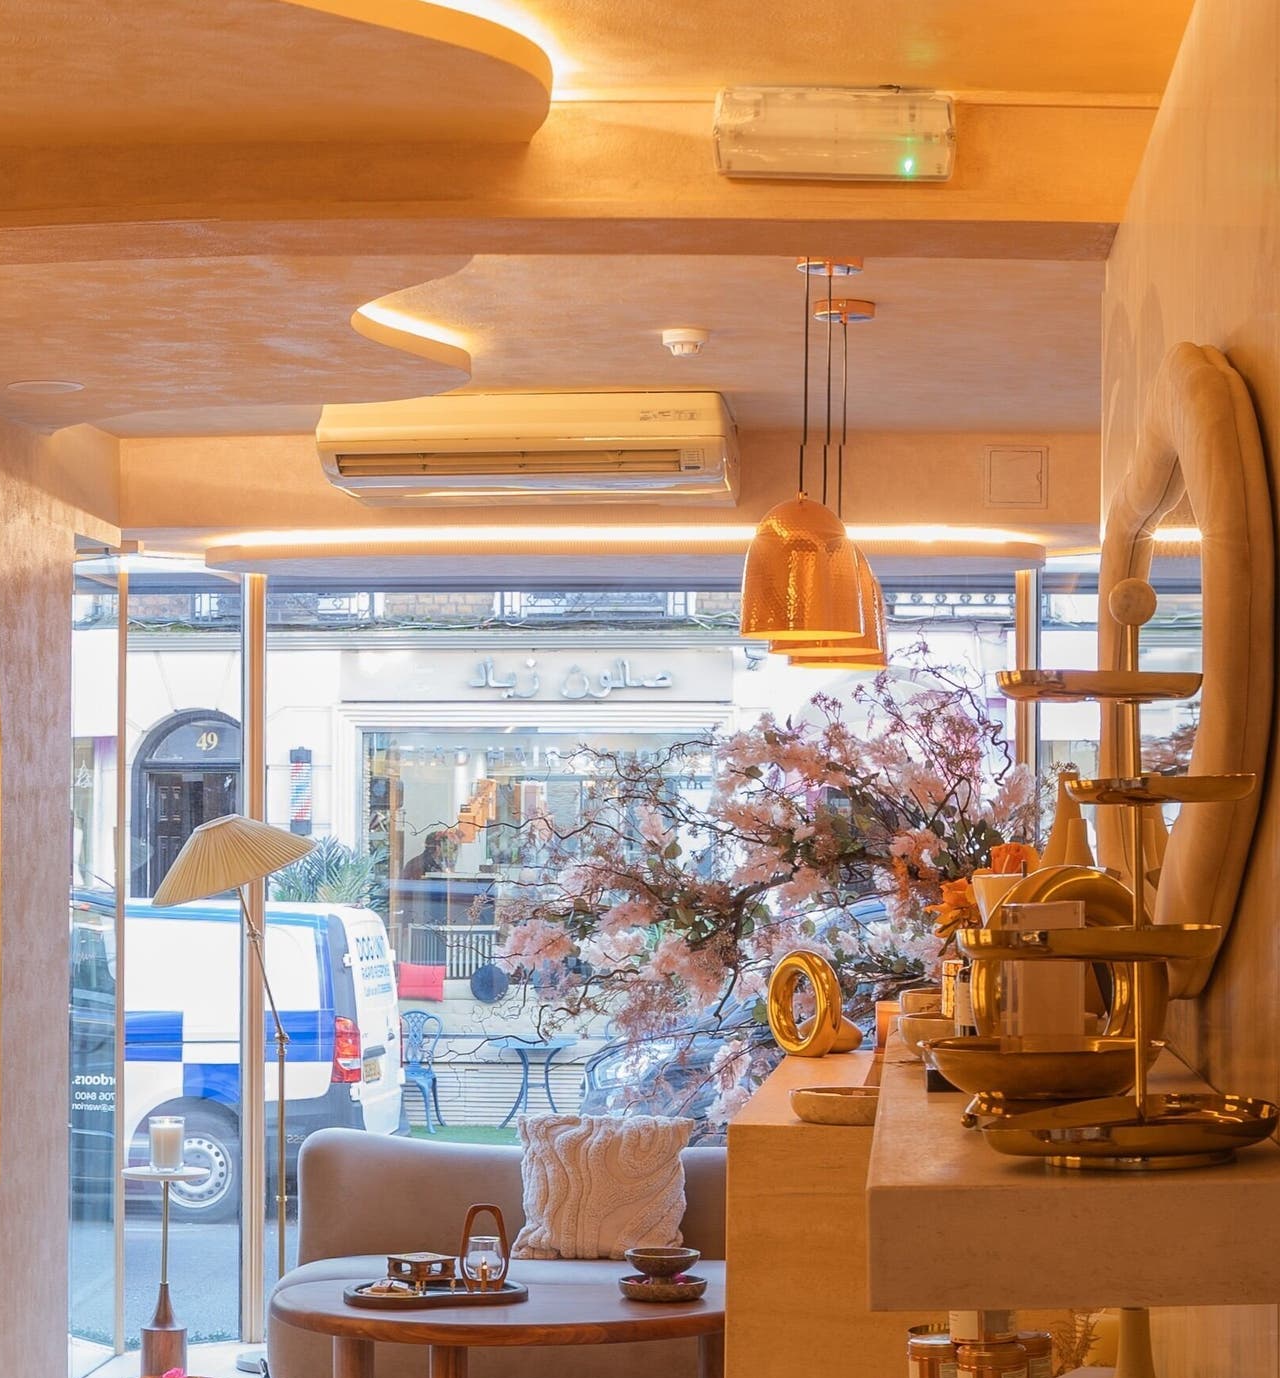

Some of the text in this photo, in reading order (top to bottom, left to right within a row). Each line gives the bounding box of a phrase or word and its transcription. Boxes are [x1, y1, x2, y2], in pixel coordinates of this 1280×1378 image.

[469, 655, 673, 699] صالون زياد
[196, 732, 218, 751] 49
